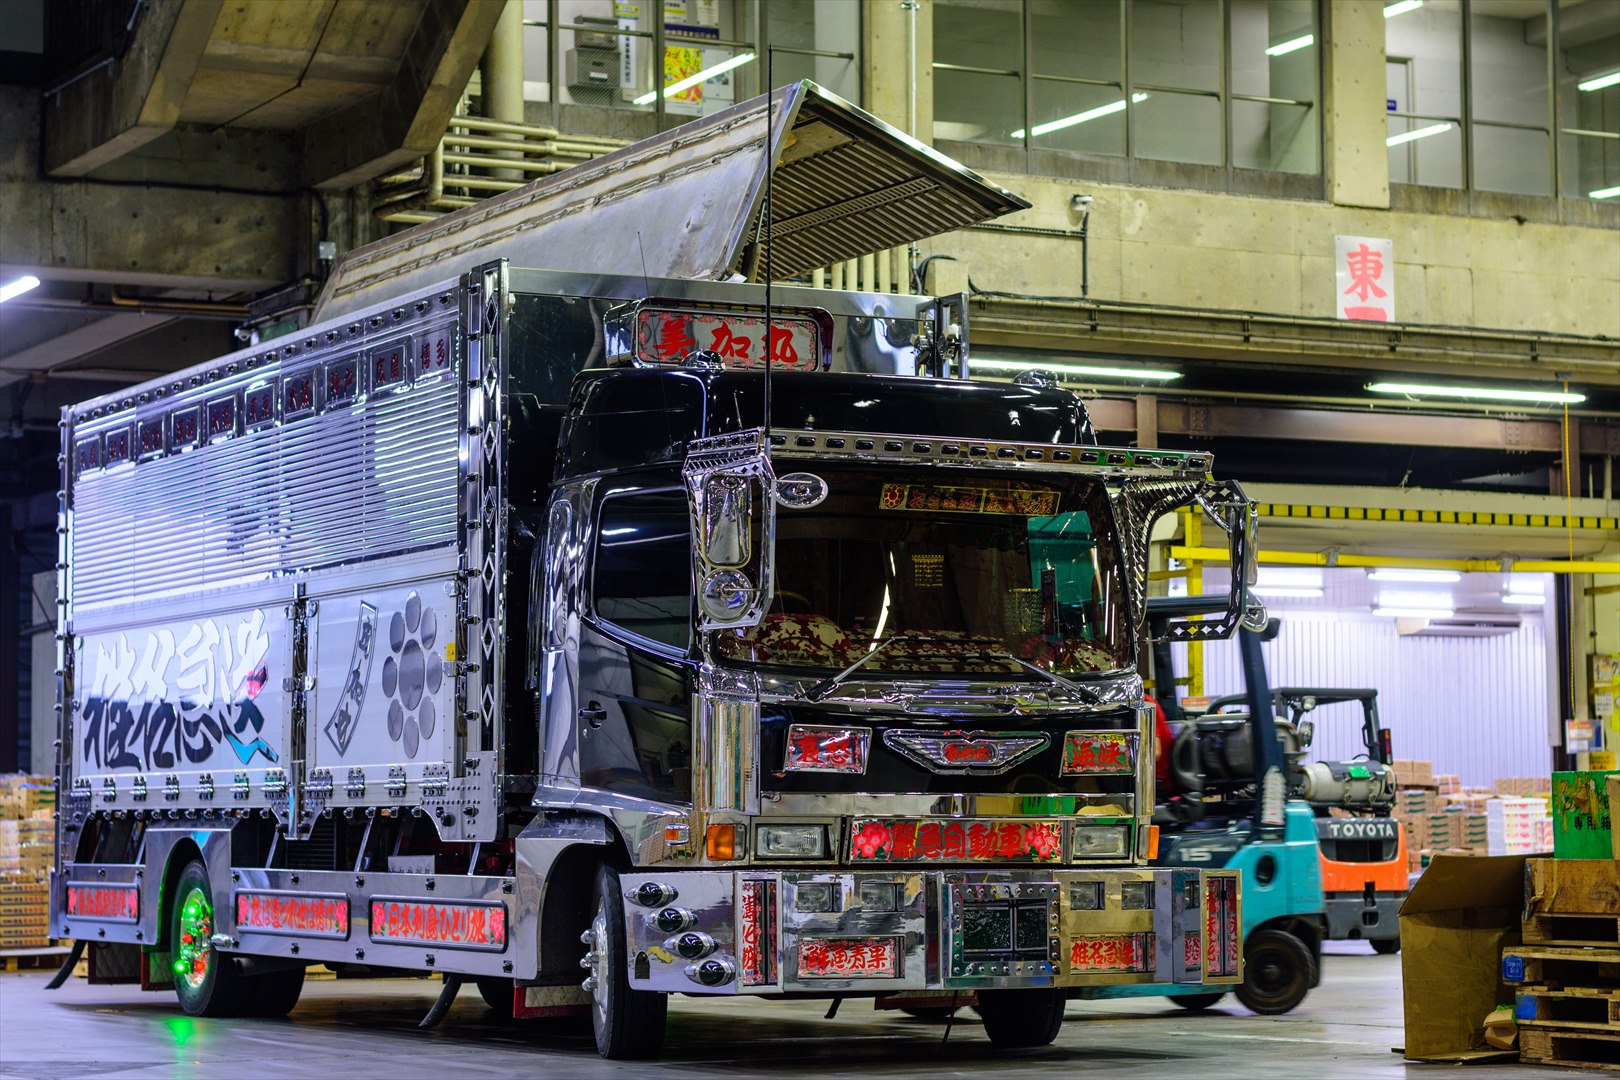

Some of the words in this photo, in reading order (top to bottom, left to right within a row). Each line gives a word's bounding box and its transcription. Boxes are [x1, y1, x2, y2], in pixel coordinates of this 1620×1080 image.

[420, 338, 445, 370] 博多
[652, 318, 798, 362] 美加丸
[797, 736, 850, 765] 哀愁
[1071, 740, 1123, 766] 海峡
[892, 823, 1024, 858] 緊急自動車
[1330, 823, 1394, 837] TOYOTA
[1179, 848, 1212, 861] 15
[388, 903, 489, 943] 日本列島ひとり旅
[805, 944, 888, 970] 鮮魚青果
